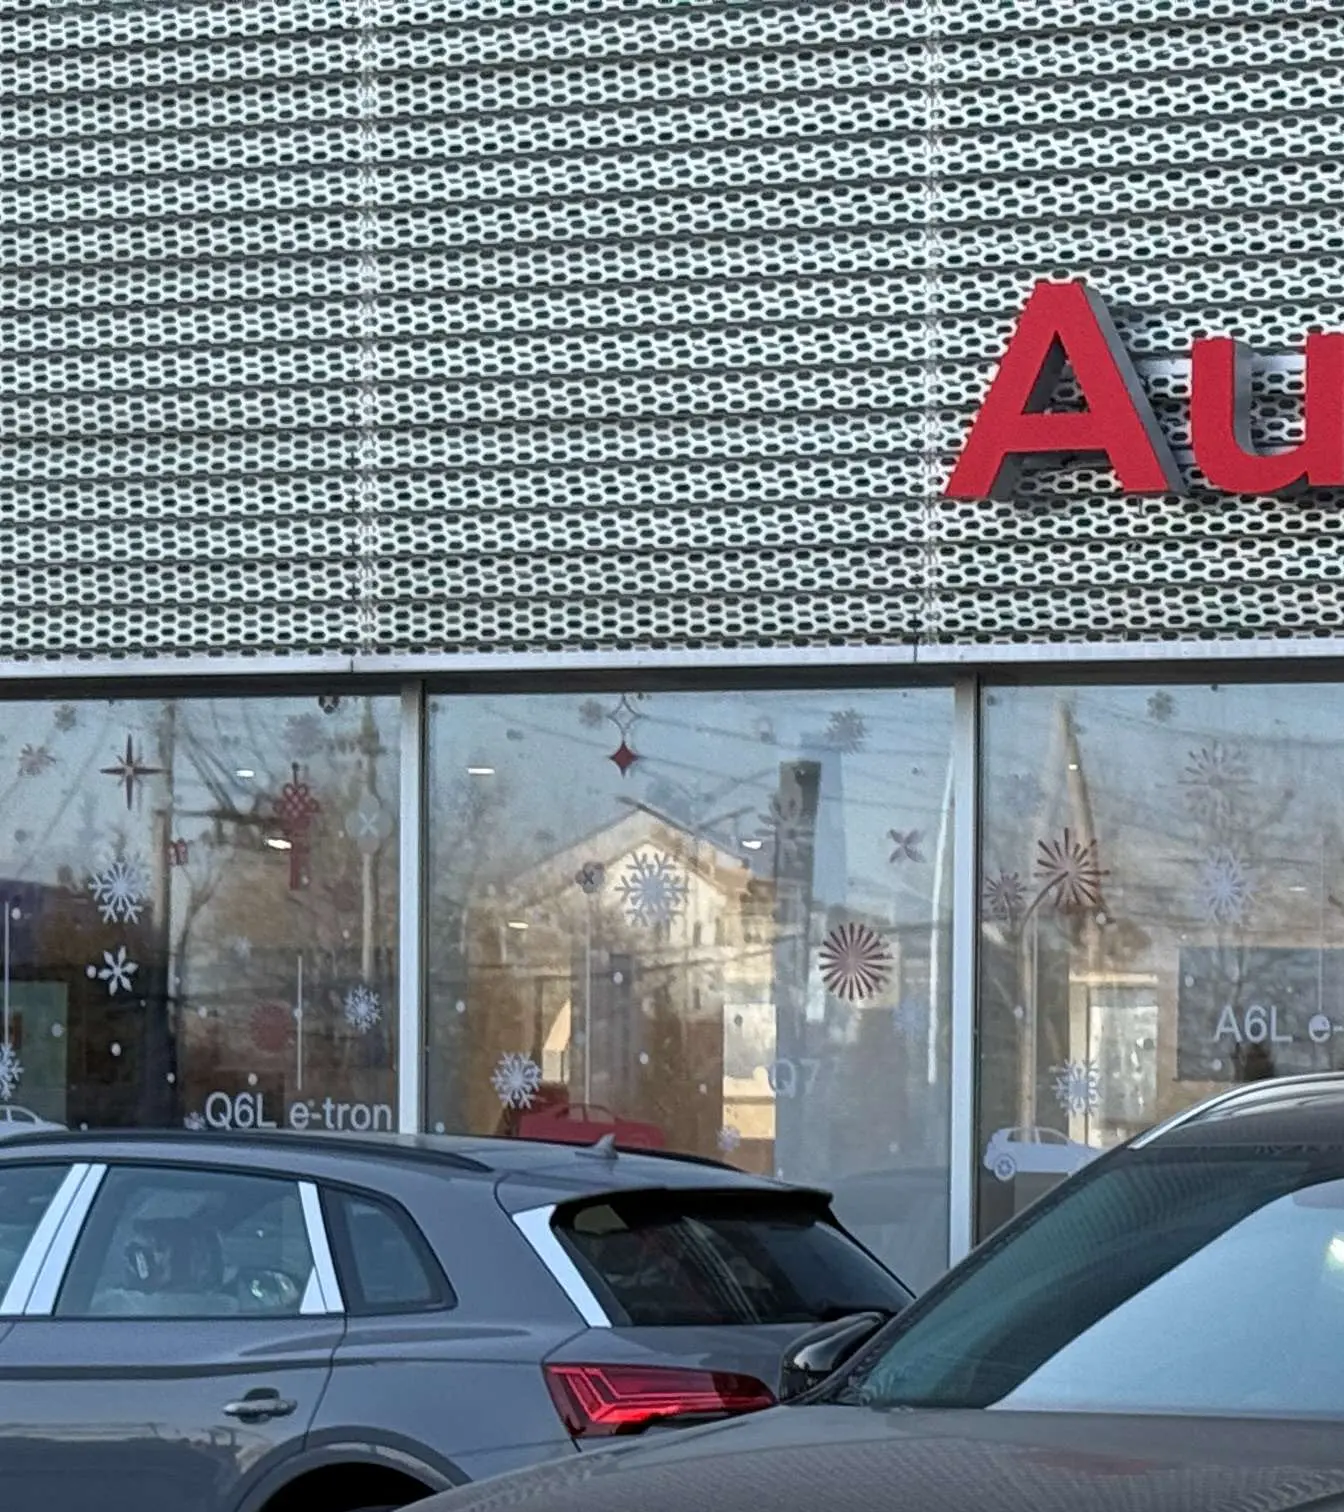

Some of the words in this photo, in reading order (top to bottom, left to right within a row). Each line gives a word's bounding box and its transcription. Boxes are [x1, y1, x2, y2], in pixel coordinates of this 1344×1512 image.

[1212, 1004, 1293, 1044] A6L
[205, 1091, 277, 1130] Q6L
[289, 1096, 393, 1131] e-tron
